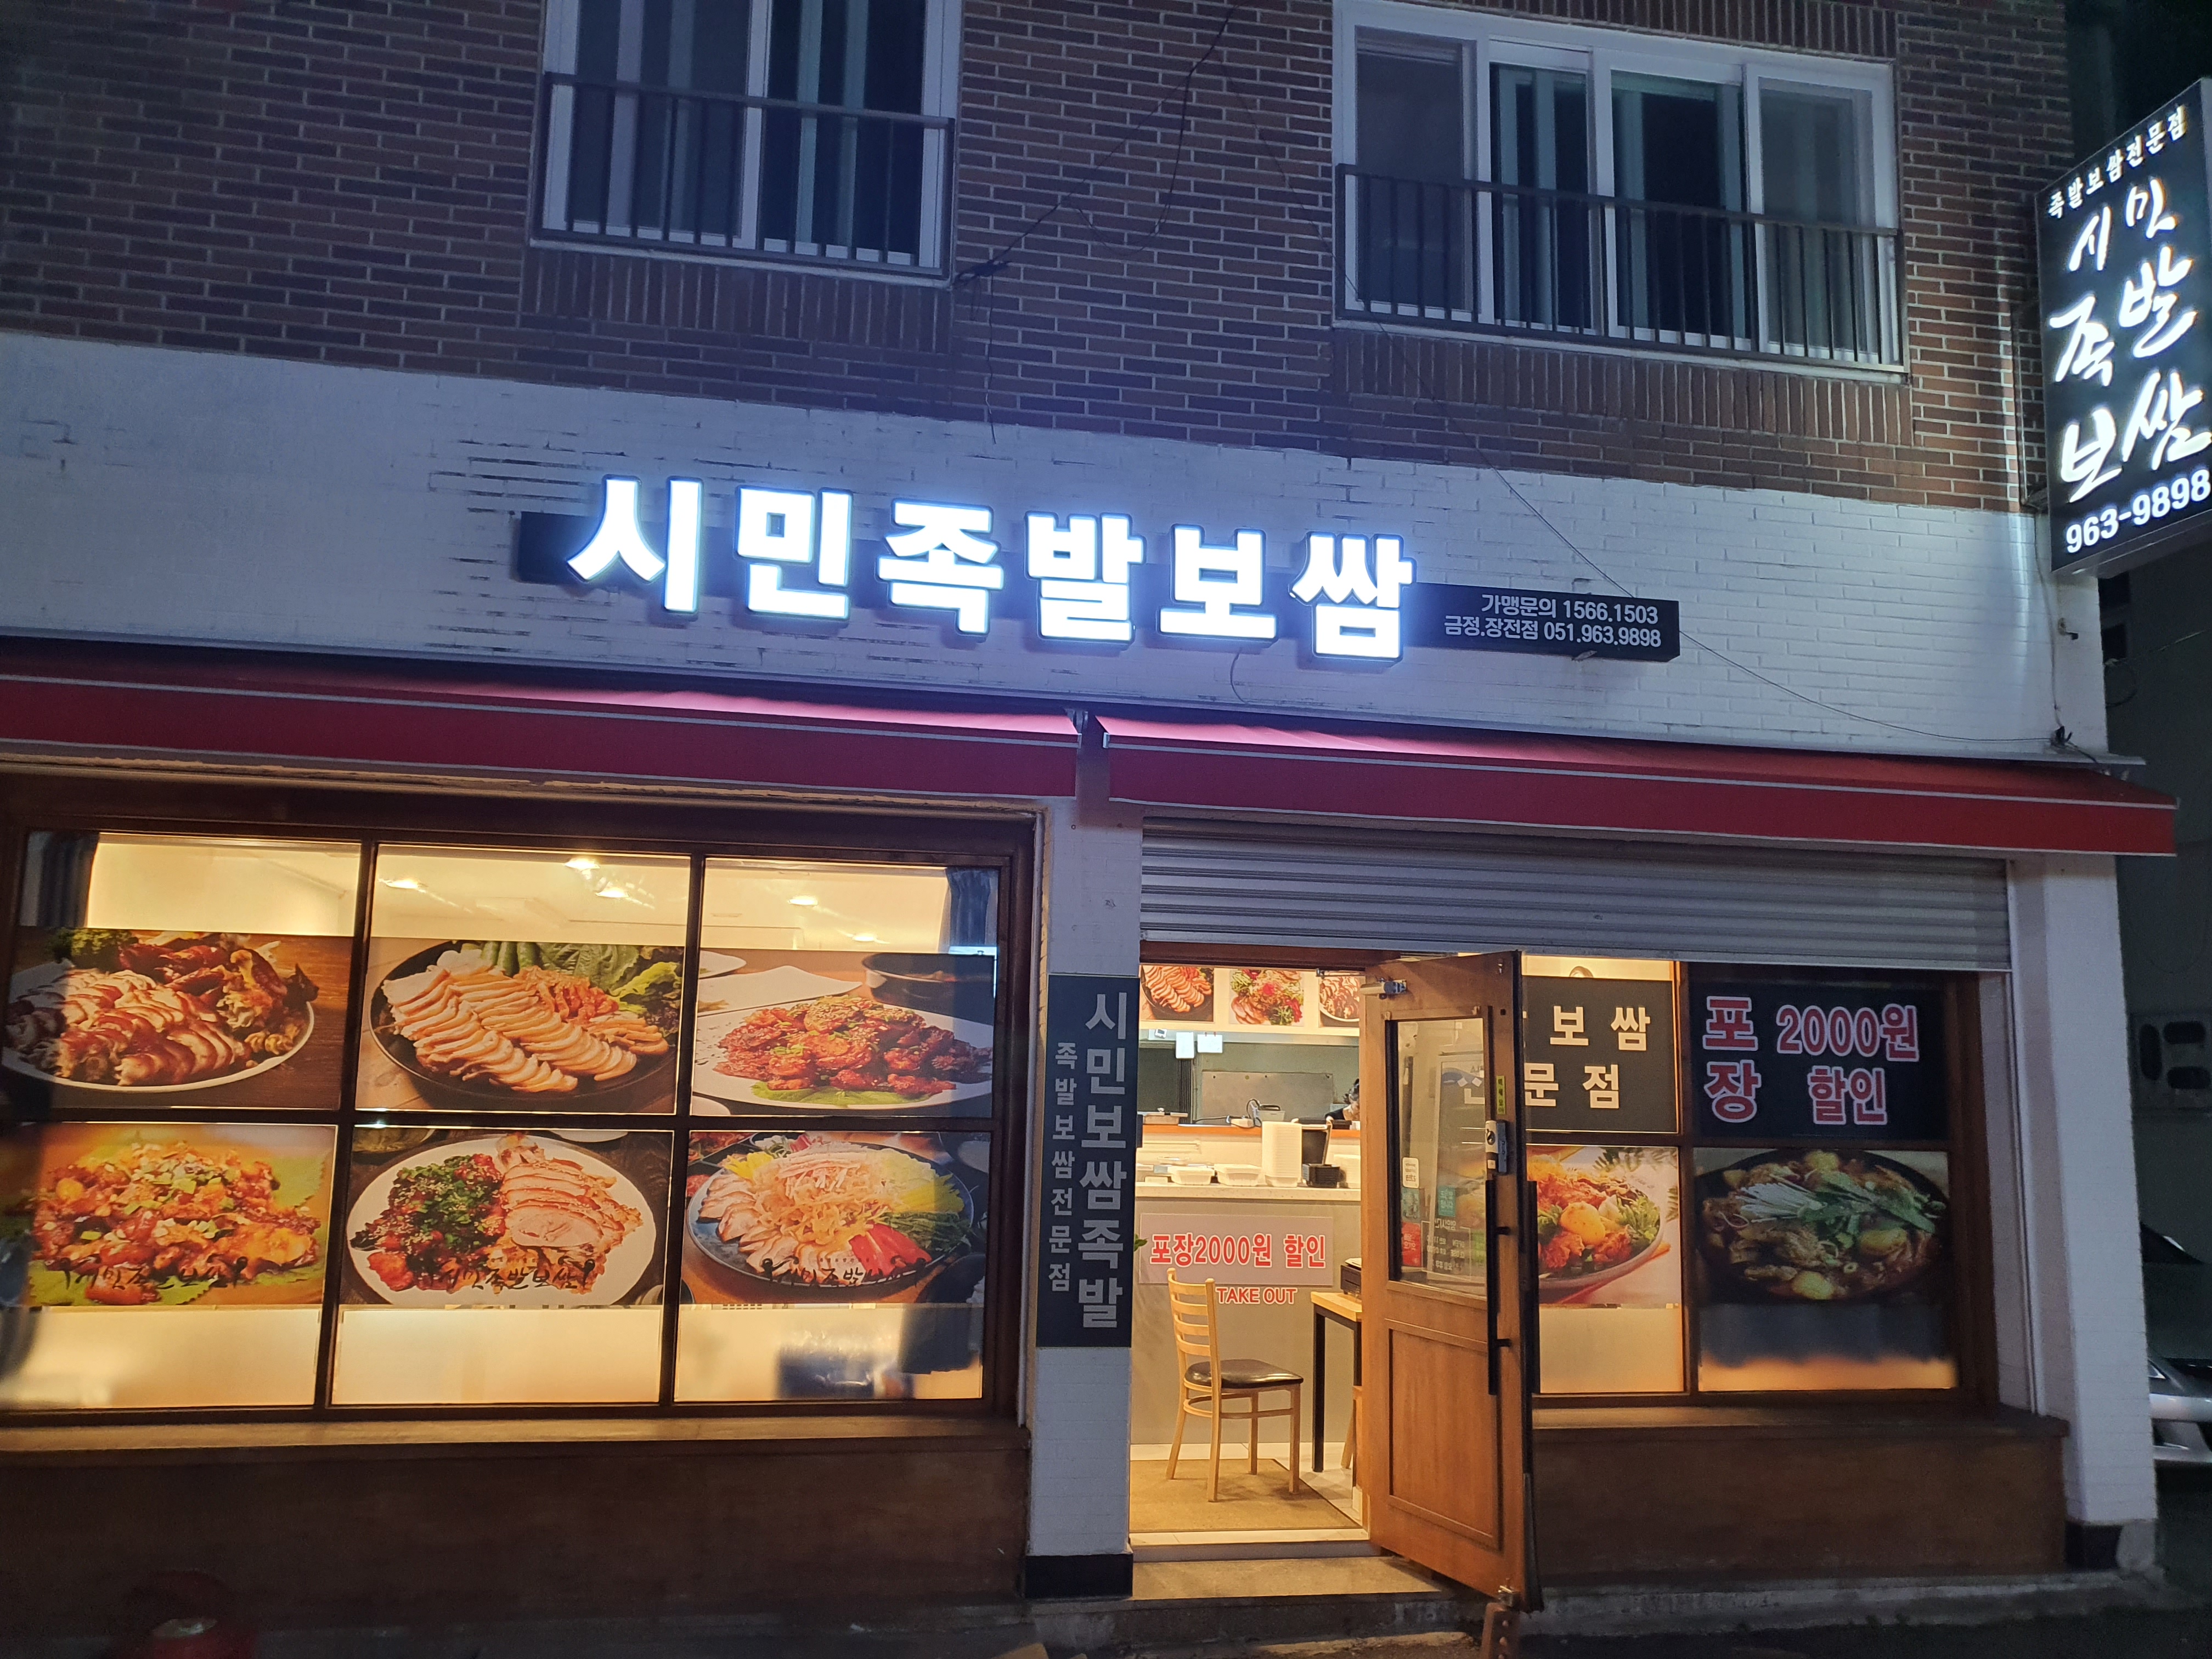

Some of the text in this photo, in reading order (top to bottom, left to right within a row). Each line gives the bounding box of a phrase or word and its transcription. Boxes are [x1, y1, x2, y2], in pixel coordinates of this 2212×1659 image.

[2047, 105, 2187, 219] 족발보쌈전문점
[2068, 177, 2177, 273] 시민
[2049, 246, 2199, 387] 족발
[2059, 370, 2212, 502] 보쌈
[2065, 469, 2211, 555] 963-9898
[567, 476, 1413, 660] 시민족발보쌈
[1481, 594, 1658, 624] 가맹문의 1566.1503
[1444, 616, 1661, 647] 금정.장전점 051.963.9898
[1776, 1003, 1919, 1062] 2000원
[1807, 1065, 1887, 1125] 할인
[1048, 1042, 1078, 1293] 족발보쌈전문점
[1079, 992, 1127, 1329] 시민보쌈족발
[1150, 1232, 1325, 1268] 포장2000원 할인
[1215, 1287, 1297, 1305] TAKE OUT
